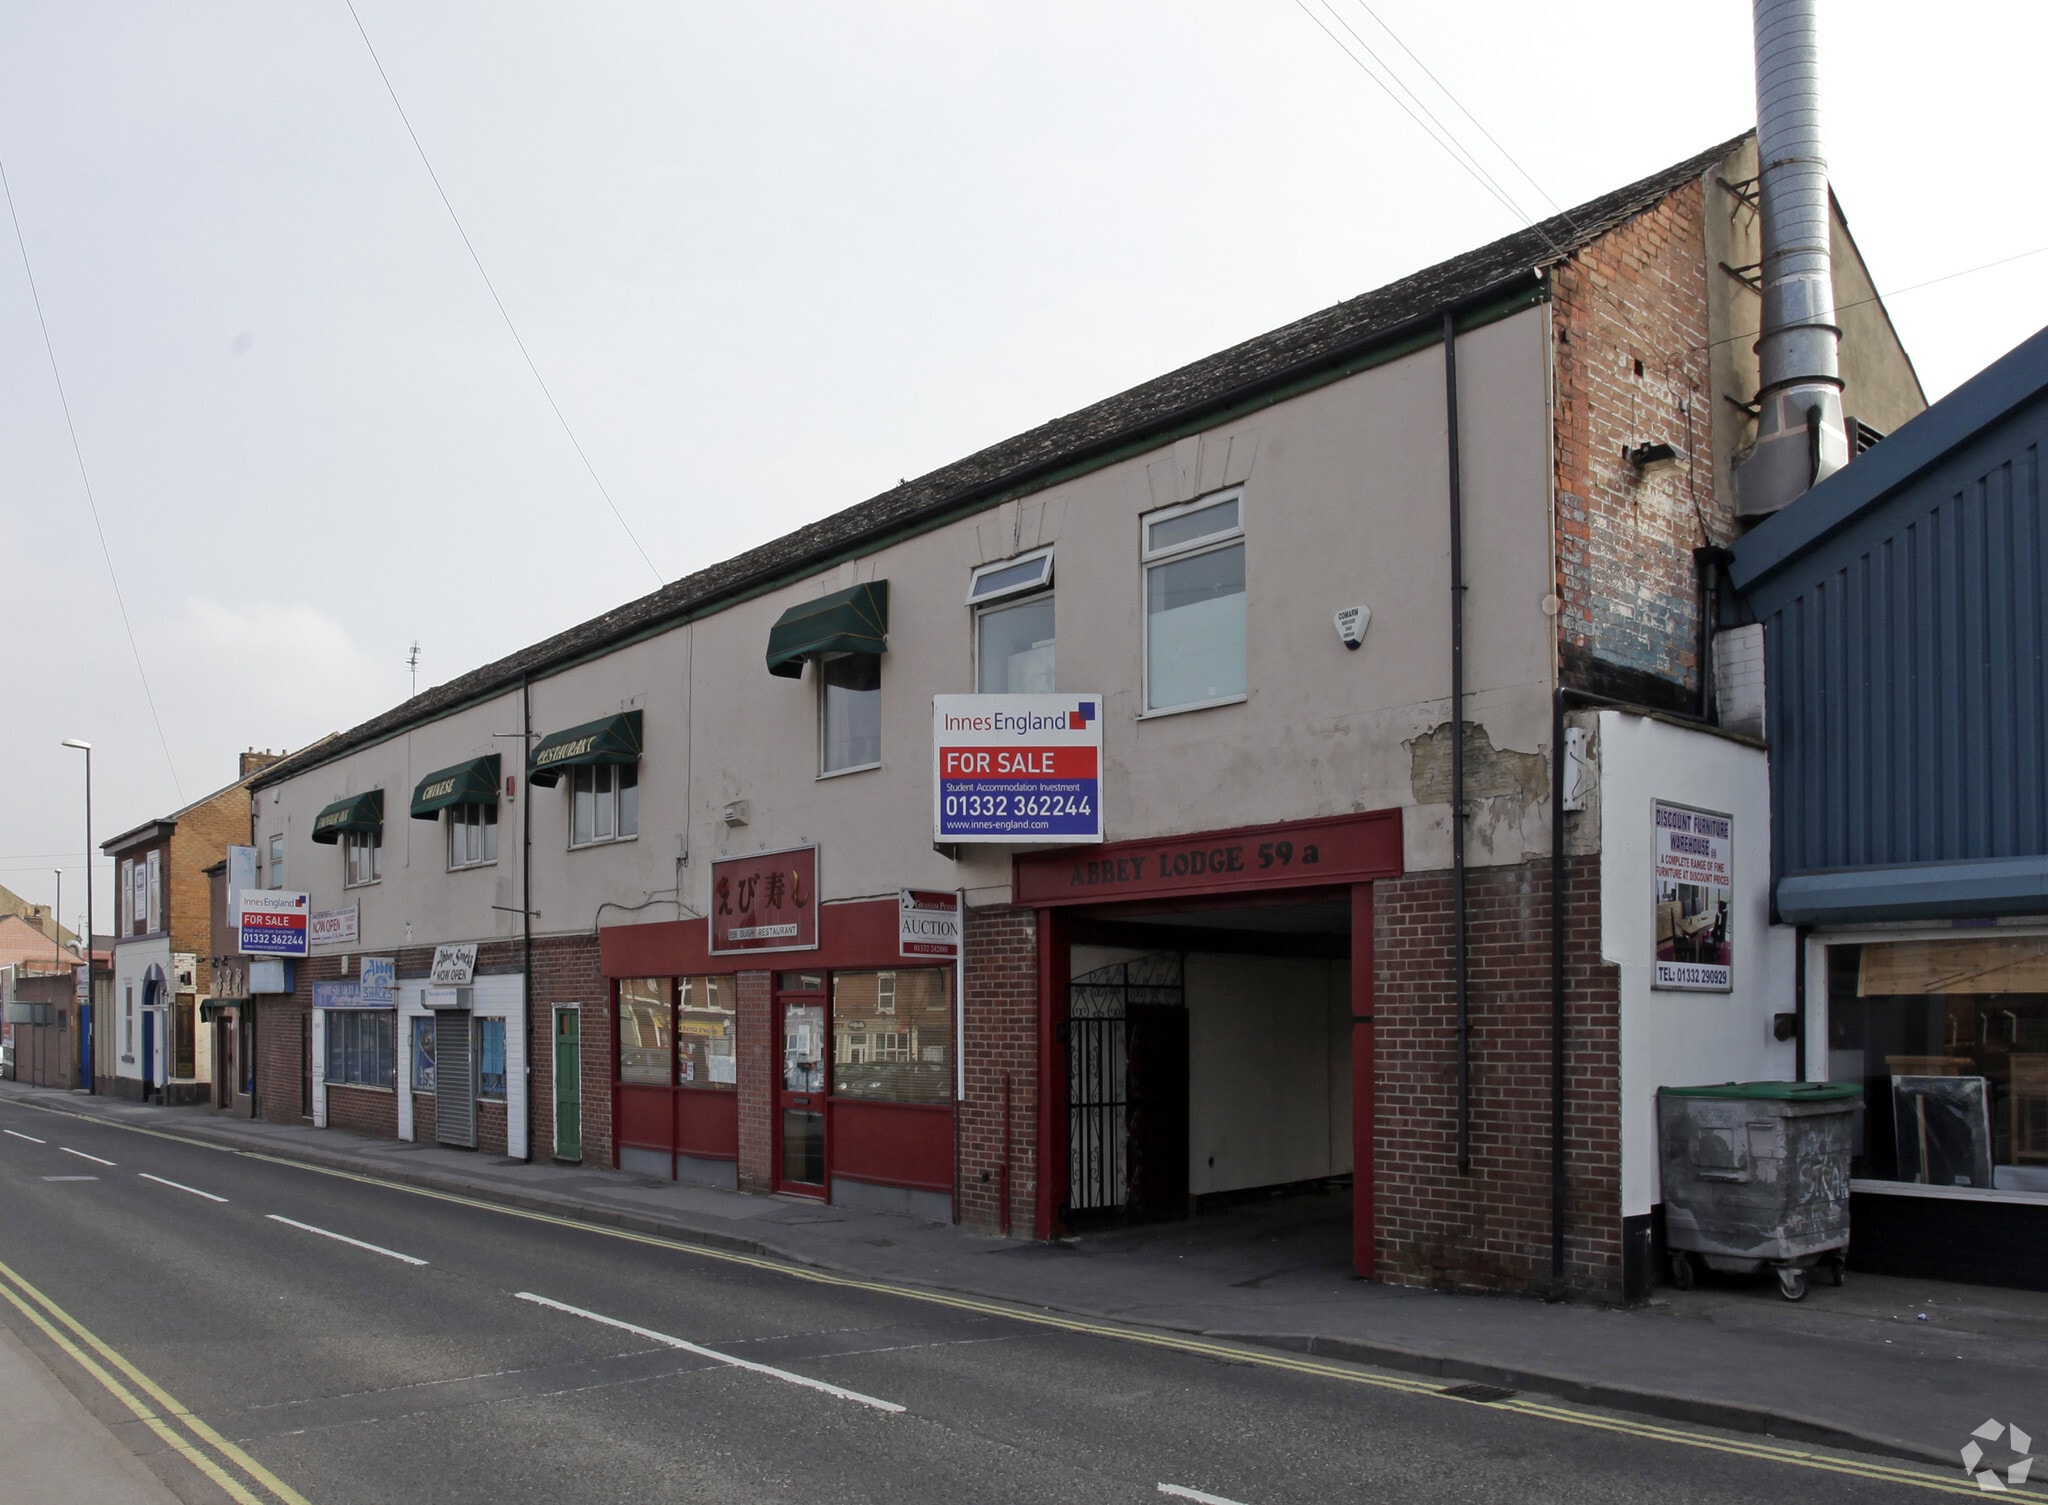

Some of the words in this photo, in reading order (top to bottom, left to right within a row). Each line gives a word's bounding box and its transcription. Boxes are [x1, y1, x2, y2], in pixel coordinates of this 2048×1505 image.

[536, 735, 597, 766] RESTAURANT
[946, 752, 991, 774] FOR
[996, 752, 1055, 774] SALE
[422, 777, 456, 801] CHINESE
[945, 782, 974, 793] Student
[976, 782, 1038, 793] Accommodation
[1039, 782, 1081, 793] Investment
[945, 795, 1009, 817] 01332
[1013, 795, 1092, 817] 362244
[945, 818, 1050, 831] www.innes-england.com
[1655, 808, 1692, 832] DISCOUNT
[1693, 814, 1729, 840] FURNITURE
[1670, 832, 1710, 857] WAREHOUSE
[1070, 856, 1146, 887] ABBEY
[1159, 846, 1245, 878] LODGE
[1257, 841, 1295, 869] 59
[1301, 844, 1321, 865] a
[1665, 854, 1690, 868] COMPLETE
[1690, 858, 1707, 870] RANGE
[1713, 862, 1725, 873] FINE
[1682, 869, 1689, 880] AT
[1689, 871, 1713, 883] DISCOUNT
[1713, 874, 1730, 886] PRICES
[244, 914, 263, 925] FOR
[265, 915, 289, 926] SALE
[902, 919, 958, 937] AUCTION
[243, 933, 270, 944] 01332
[271, 934, 304, 946] 362244
[757, 925, 797, 937] RESTAURANT
[362, 959, 394, 984] Abbey
[450, 968, 468, 981] OPEN
[1658, 966, 1676, 982] TEL:
[1676, 968, 1700, 983] 01332
[1701, 969, 1728, 985] 290929
